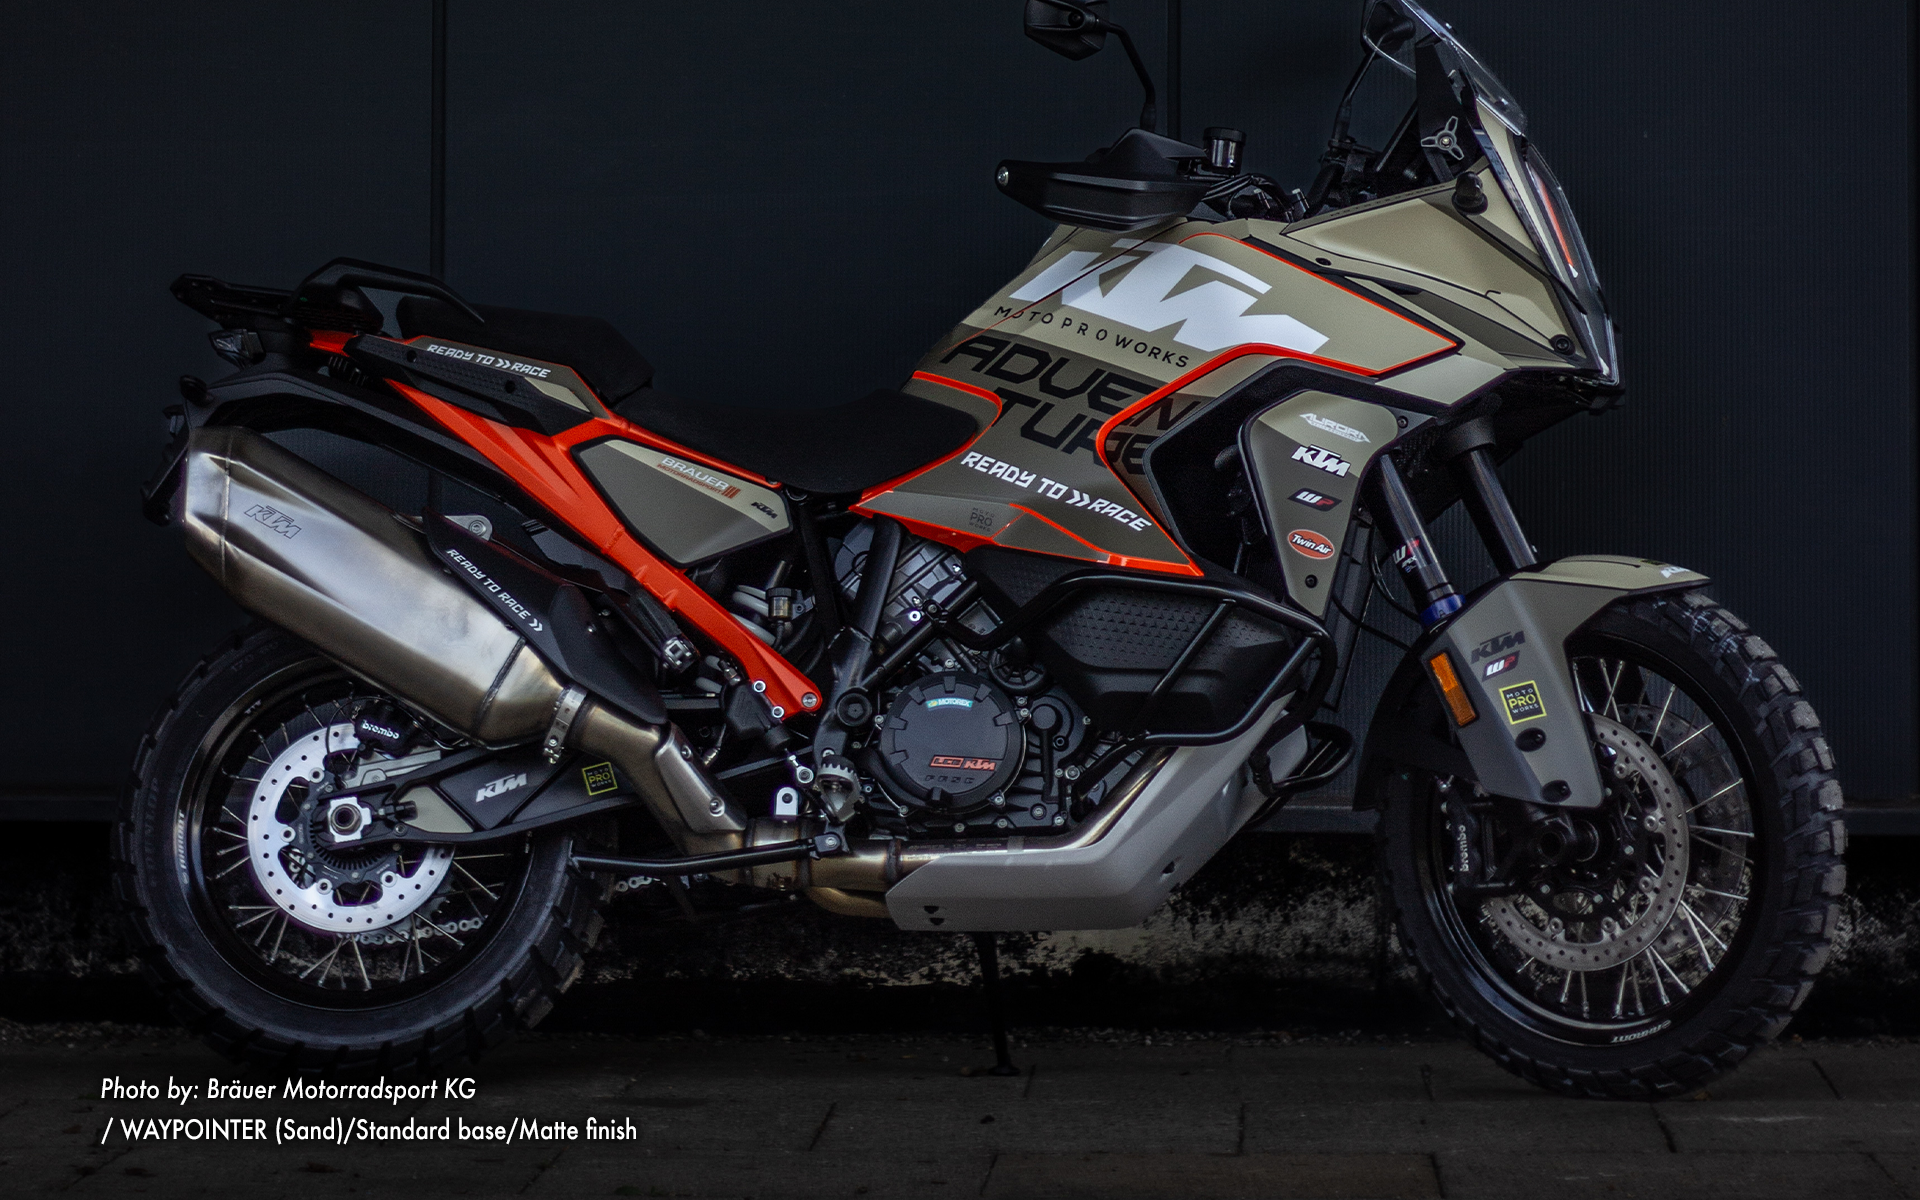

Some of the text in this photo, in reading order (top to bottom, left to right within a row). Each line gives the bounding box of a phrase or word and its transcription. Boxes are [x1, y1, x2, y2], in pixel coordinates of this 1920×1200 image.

[1009, 238, 1330, 355] KTM
[427, 344, 551, 378] READY TO RACE
[1291, 444, 1351, 478] KTM
[961, 451, 1152, 532] READY TO RACE
[243, 504, 302, 539] KTM
[751, 502, 778, 519] KTM
[970, 512, 993, 526] PRO
[1291, 533, 1332, 555] Twin Air
[446, 549, 531, 619] READY TO RACE
[1470, 630, 1526, 664] KTM
[938, 698, 970, 707] MOTOREX
[1506, 688, 1534, 700] MOTO
[1508, 693, 1537, 709] PRO
[1511, 703, 1540, 714] WORKS
[361, 720, 400, 740] brembo
[963, 758, 996, 770] KTM
[475, 773, 527, 802] KTM
[588, 772, 611, 784] PRO
[1457, 825, 1470, 871] brembo
